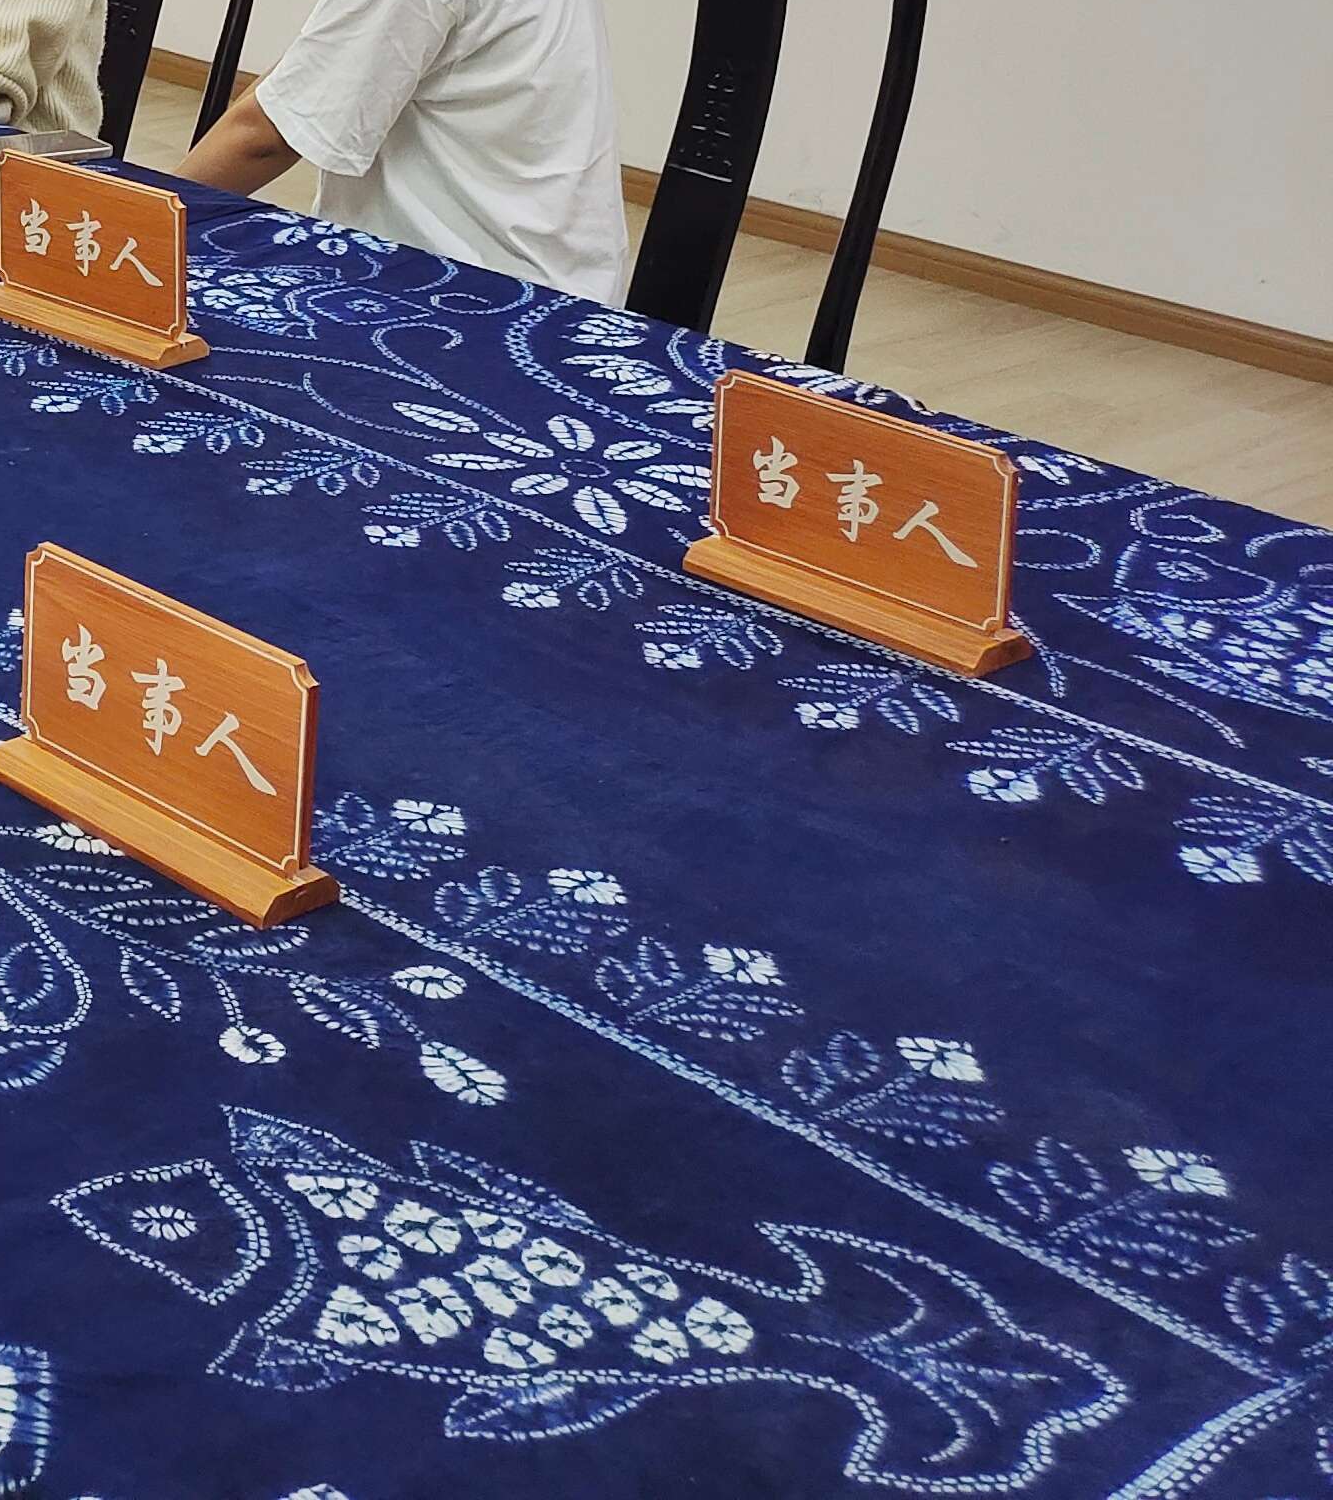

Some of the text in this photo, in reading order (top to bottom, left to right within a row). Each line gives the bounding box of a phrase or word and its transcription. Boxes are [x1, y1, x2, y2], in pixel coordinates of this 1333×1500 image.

[19, 198, 164, 288] 当事人
[749, 434, 978, 570] 当事人
[61, 623, 278, 797] 当事人
